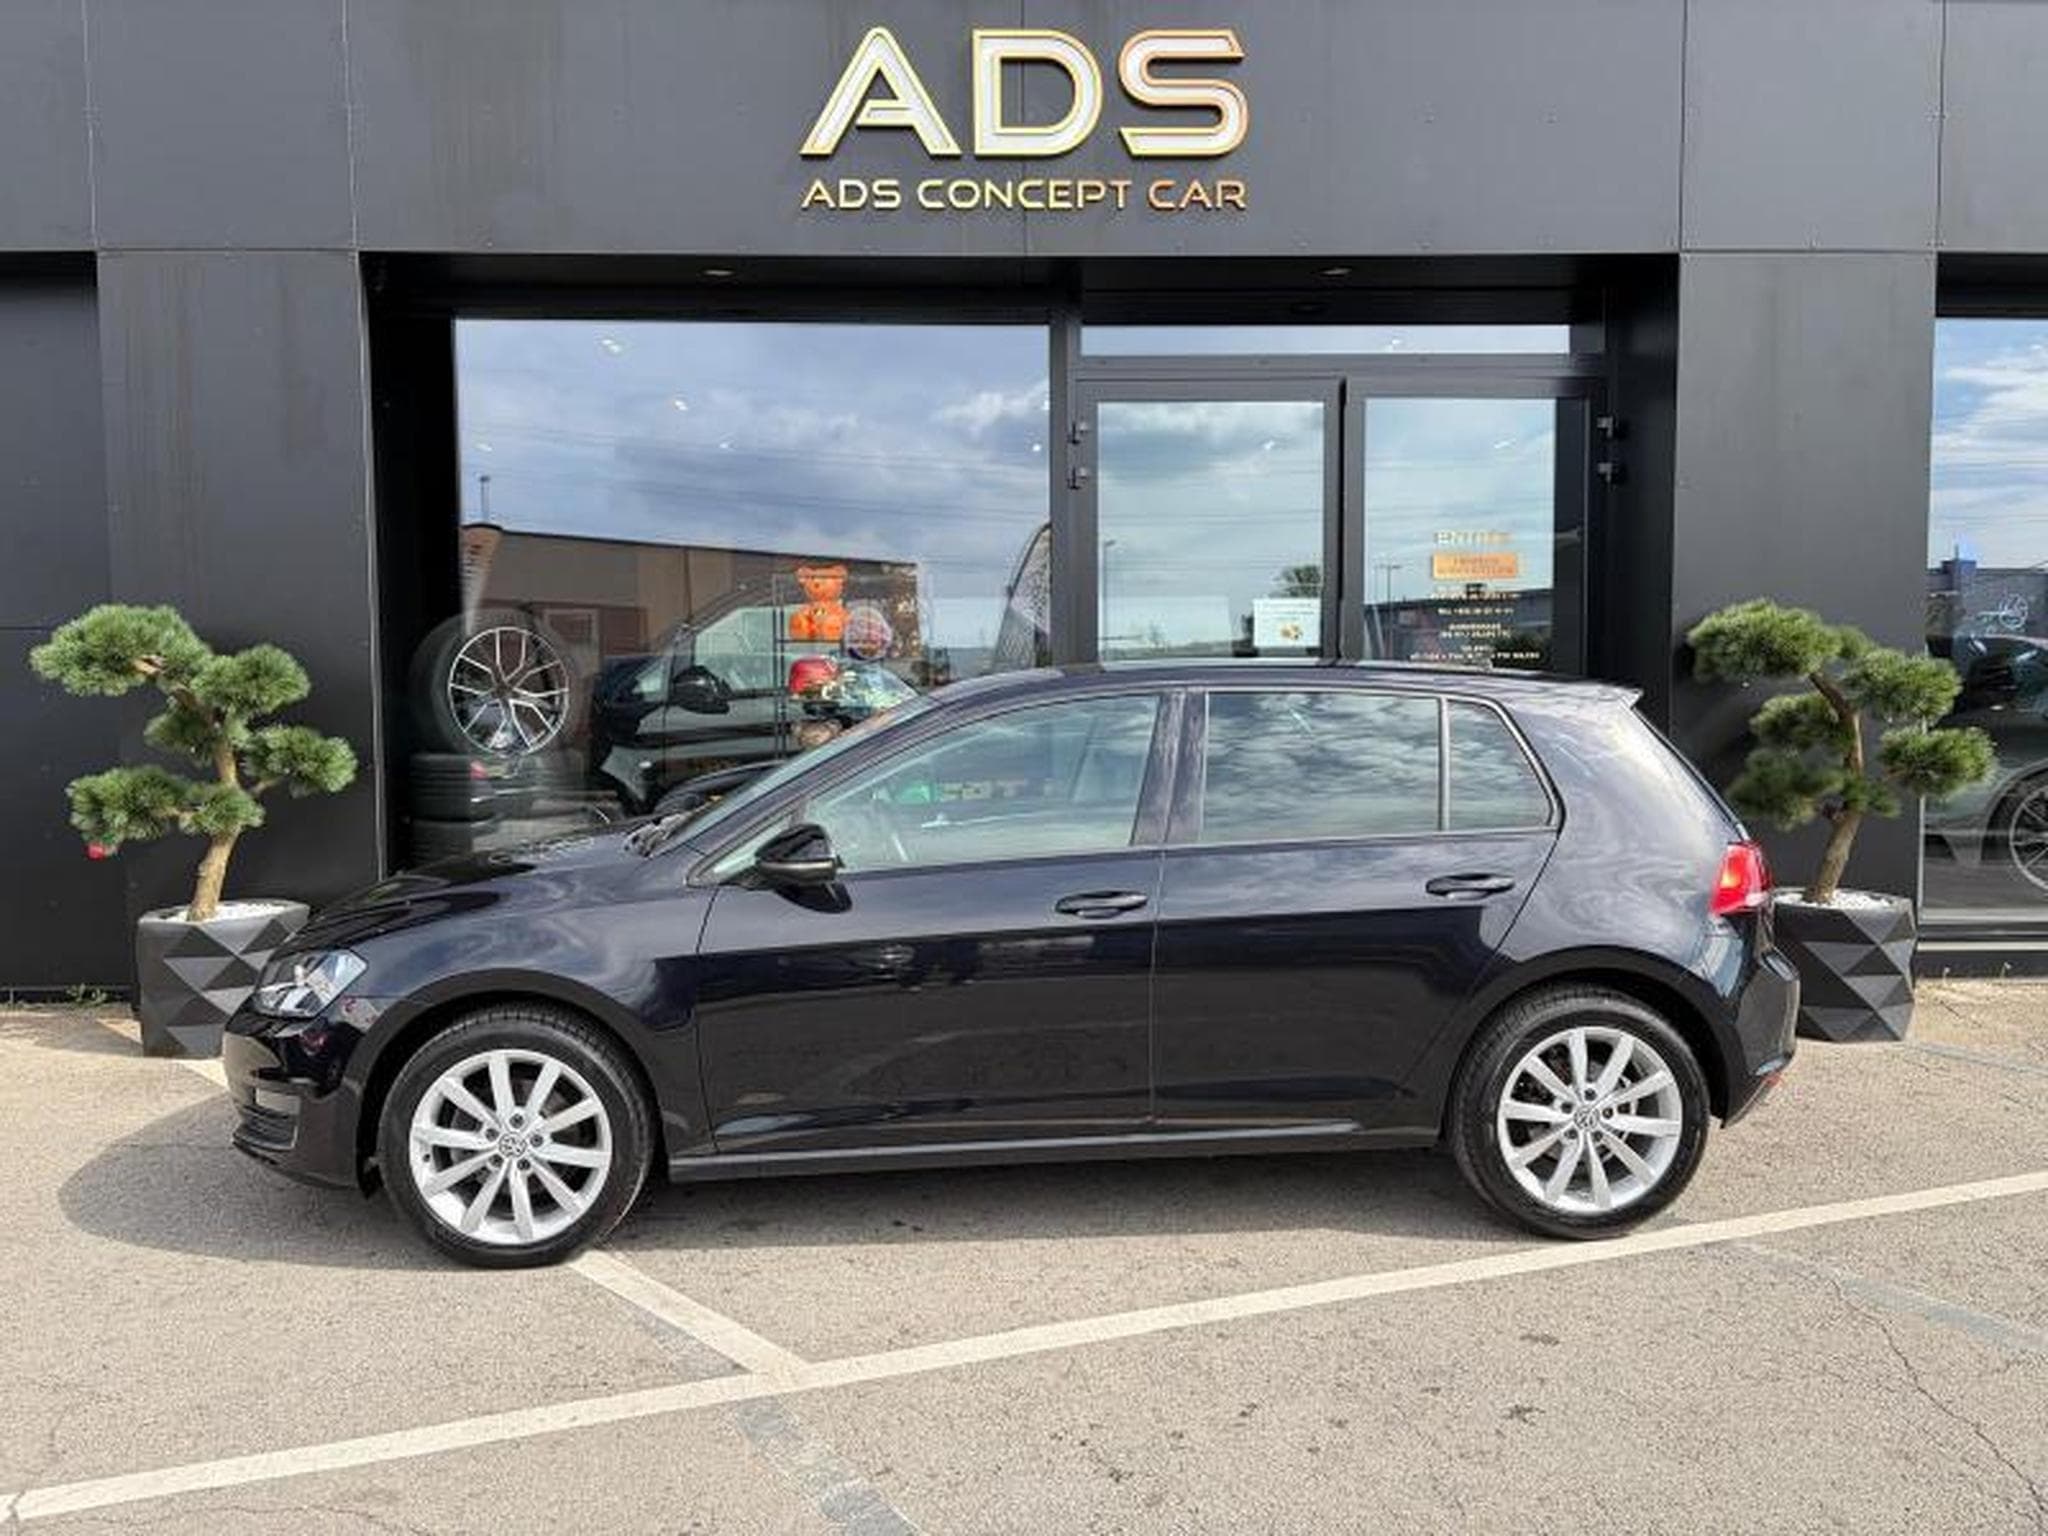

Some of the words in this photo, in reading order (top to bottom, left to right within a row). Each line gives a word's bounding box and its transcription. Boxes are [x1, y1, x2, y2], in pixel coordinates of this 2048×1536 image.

[800, 26, 1249, 156] ADS
[801, 179, 901, 210] ADS
[917, 179, 1132, 210] CONCEPT
[1148, 179, 1248, 210] CAR
